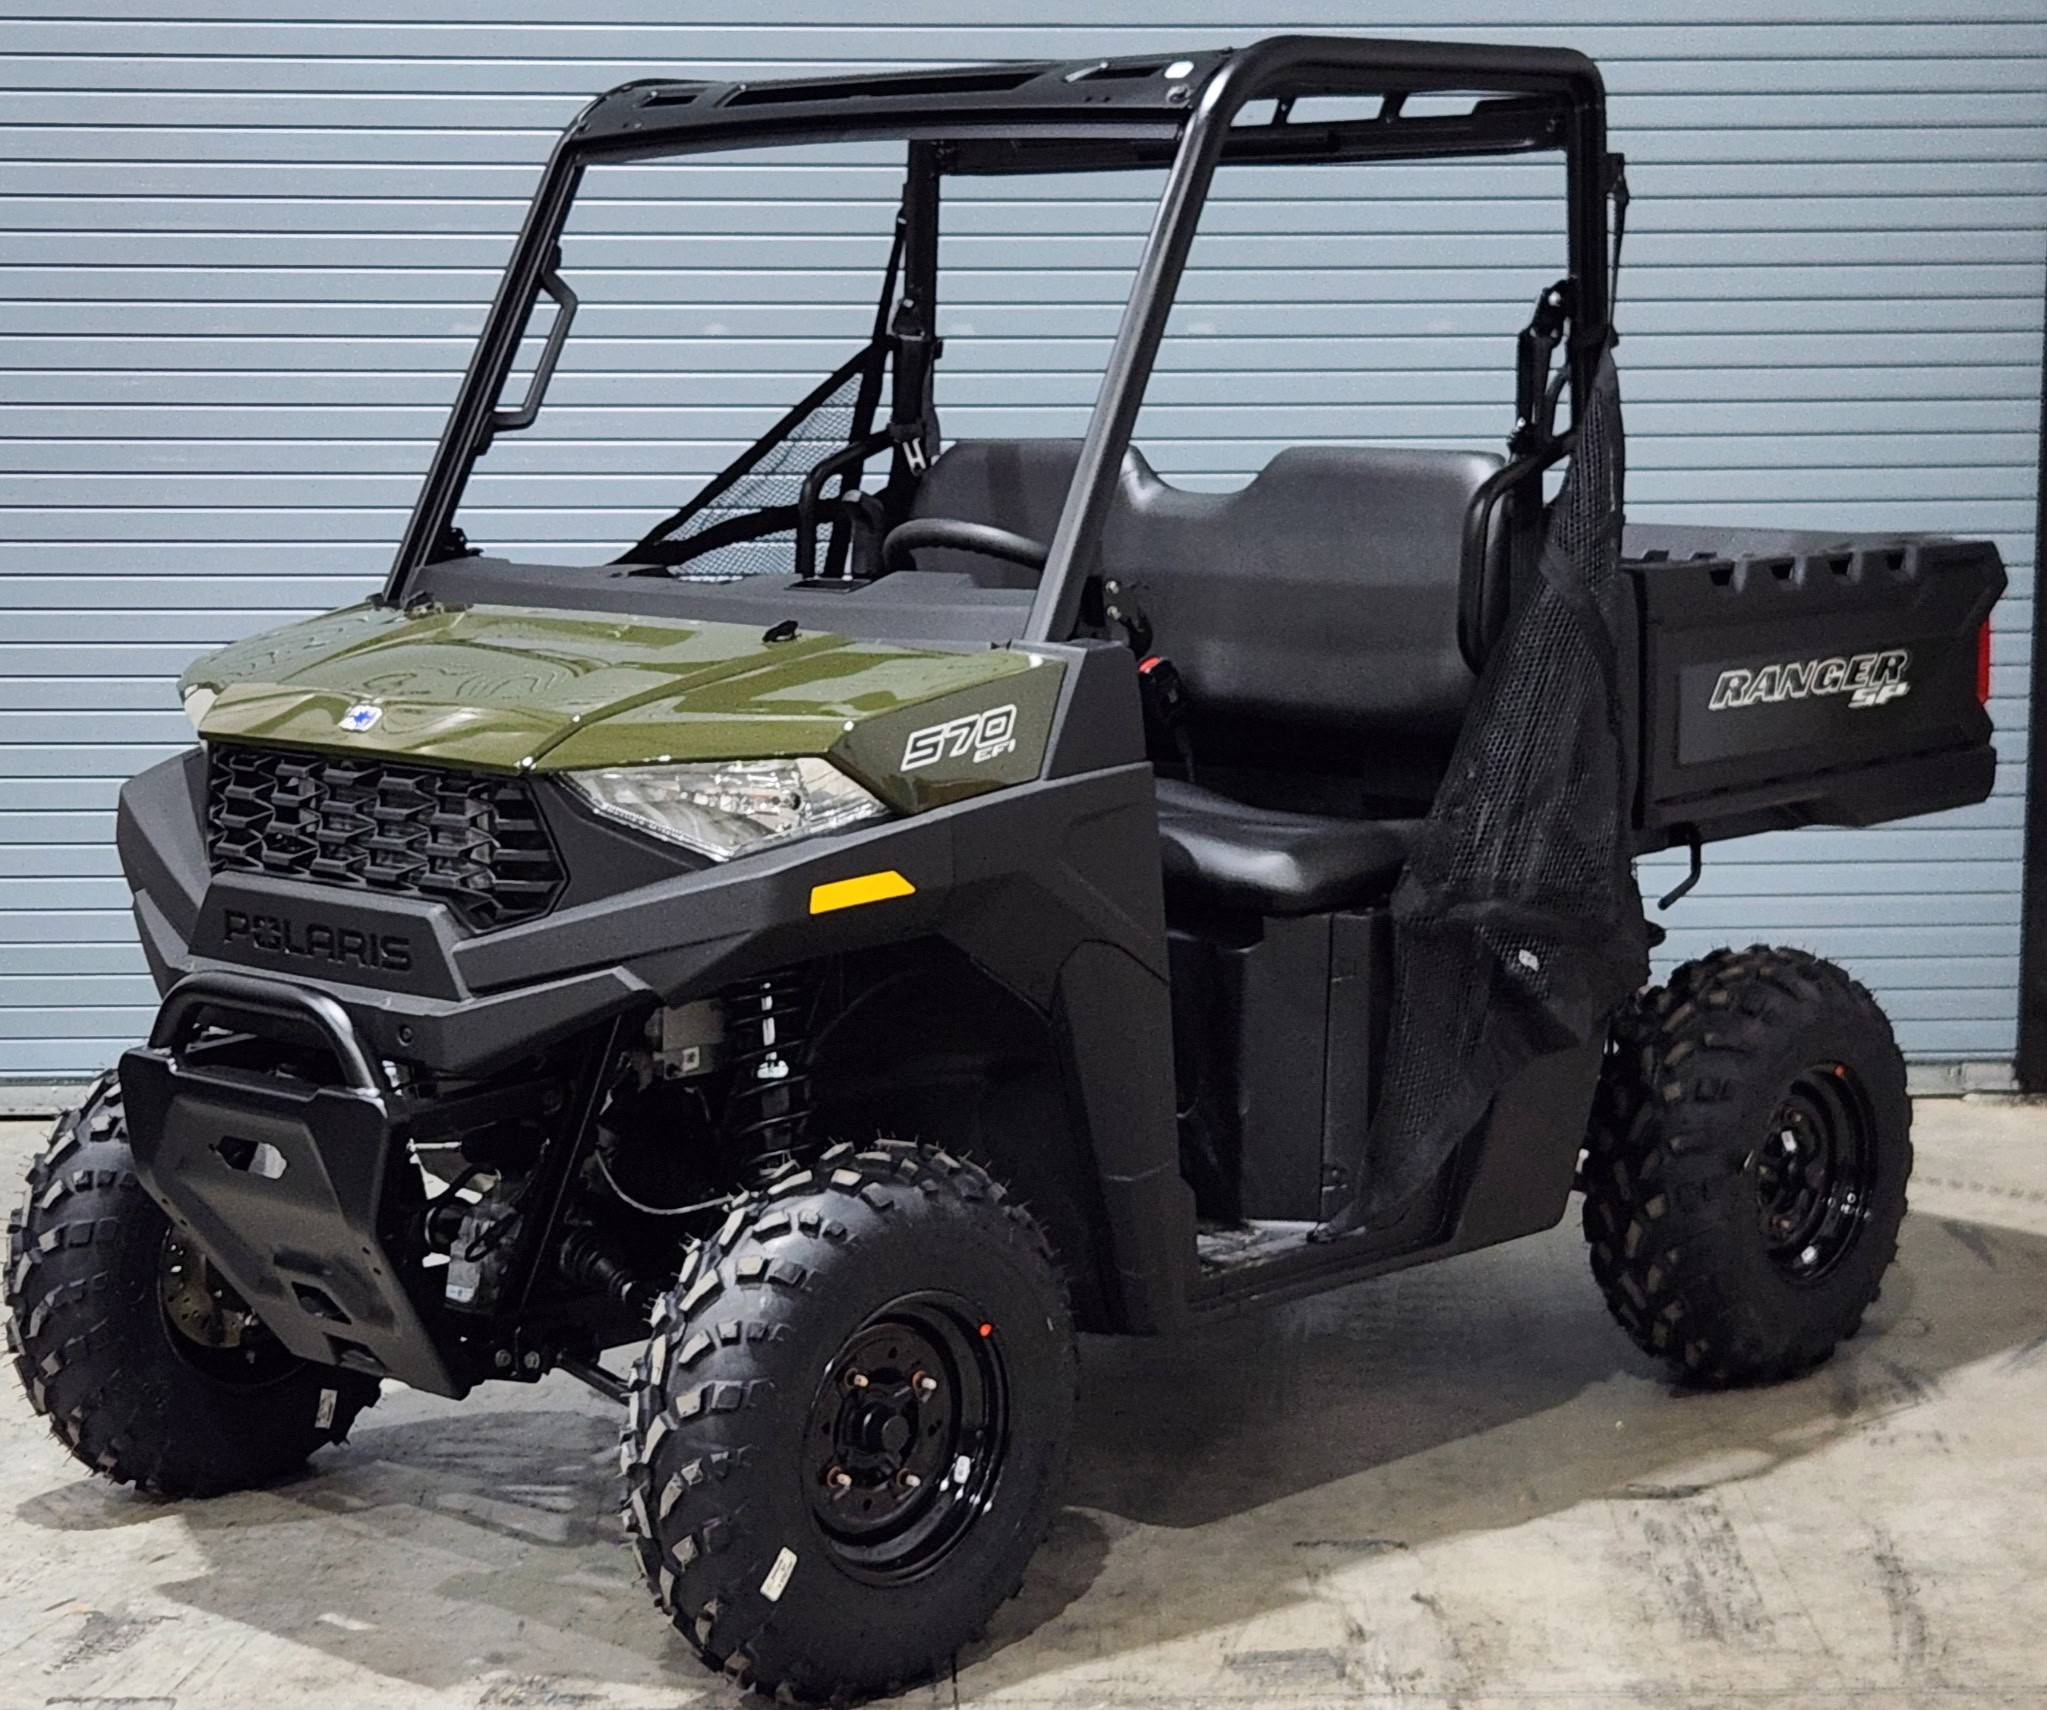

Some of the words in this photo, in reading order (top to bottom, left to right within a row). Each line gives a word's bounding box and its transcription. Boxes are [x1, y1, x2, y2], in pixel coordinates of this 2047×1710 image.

[1708, 649, 1908, 711] RANGER
[1848, 682, 1910, 708] SP
[900, 704, 1017, 772] 570
[973, 738, 1016, 763] EFI
[224, 909, 412, 972] POLARIS
